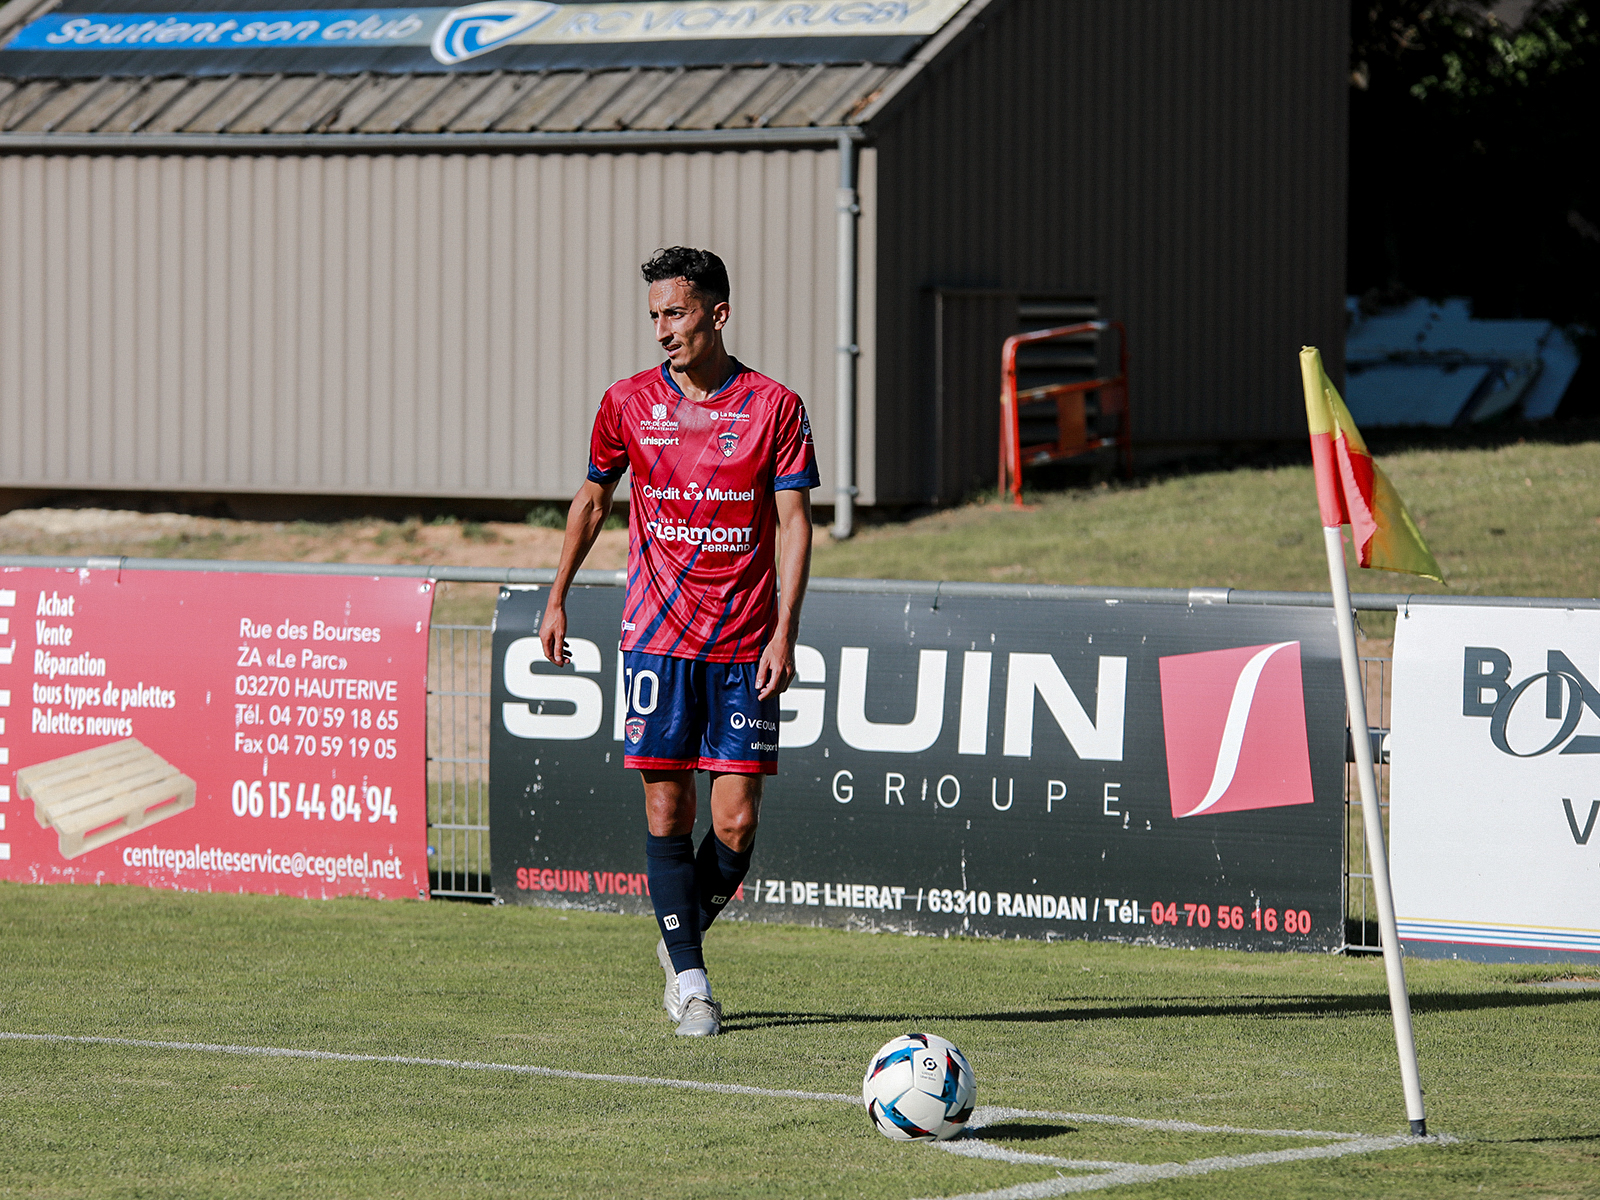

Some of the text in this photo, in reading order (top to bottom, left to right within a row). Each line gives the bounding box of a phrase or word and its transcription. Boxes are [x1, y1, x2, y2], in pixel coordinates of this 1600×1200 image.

[46, 13, 423, 44] Soutient son club
[556, 0, 929, 36] RC VICHY RUGBY
[640, 436, 680, 447] uhlsport
[642, 484, 754, 501] Crédit Mutuel
[36, 590, 75, 617] Achat
[36, 619, 73, 646] Vente
[240, 618, 381, 642] Rue des Bourses
[34, 649, 106, 680] Réparation
[236, 646, 348, 670] ZA «Le Parc»
[32, 680, 176, 712] tous types de palettes
[235, 674, 398, 701] 03270 HAUTERIVE
[32, 707, 133, 737] Palettes neuves
[234, 703, 398, 730] Tél. 04 70 59 18 65
[234, 732, 397, 759] Fax 04 70 59 19 05
[751, 741, 778, 752] uhlsport
[232, 780, 398, 824] 06 15 44 84 94
[832, 769, 1122, 816] GROUPE
[122, 844, 402, 883] centrepaletteservice@cegetel.net
[516, 867, 590, 894] SEGUIN
[754, 878, 761, 903] /
[765, 880, 786, 904] ZI
[792, 881, 819, 906] DE
[824, 883, 906, 910] LHERAT
[916, 887, 924, 911] /
[928, 889, 991, 916] 63310
[997, 892, 1087, 924] RANDAN
[1092, 898, 1099, 922] /
[1104, 898, 1145, 924] Tél.
[1151, 901, 1178, 926] 04
[1184, 903, 1211, 928] 70
[1217, 905, 1244, 930] 56
[1251, 907, 1278, 932] 16
[1284, 909, 1311, 934] 80
[666, 918, 678, 928] 10
